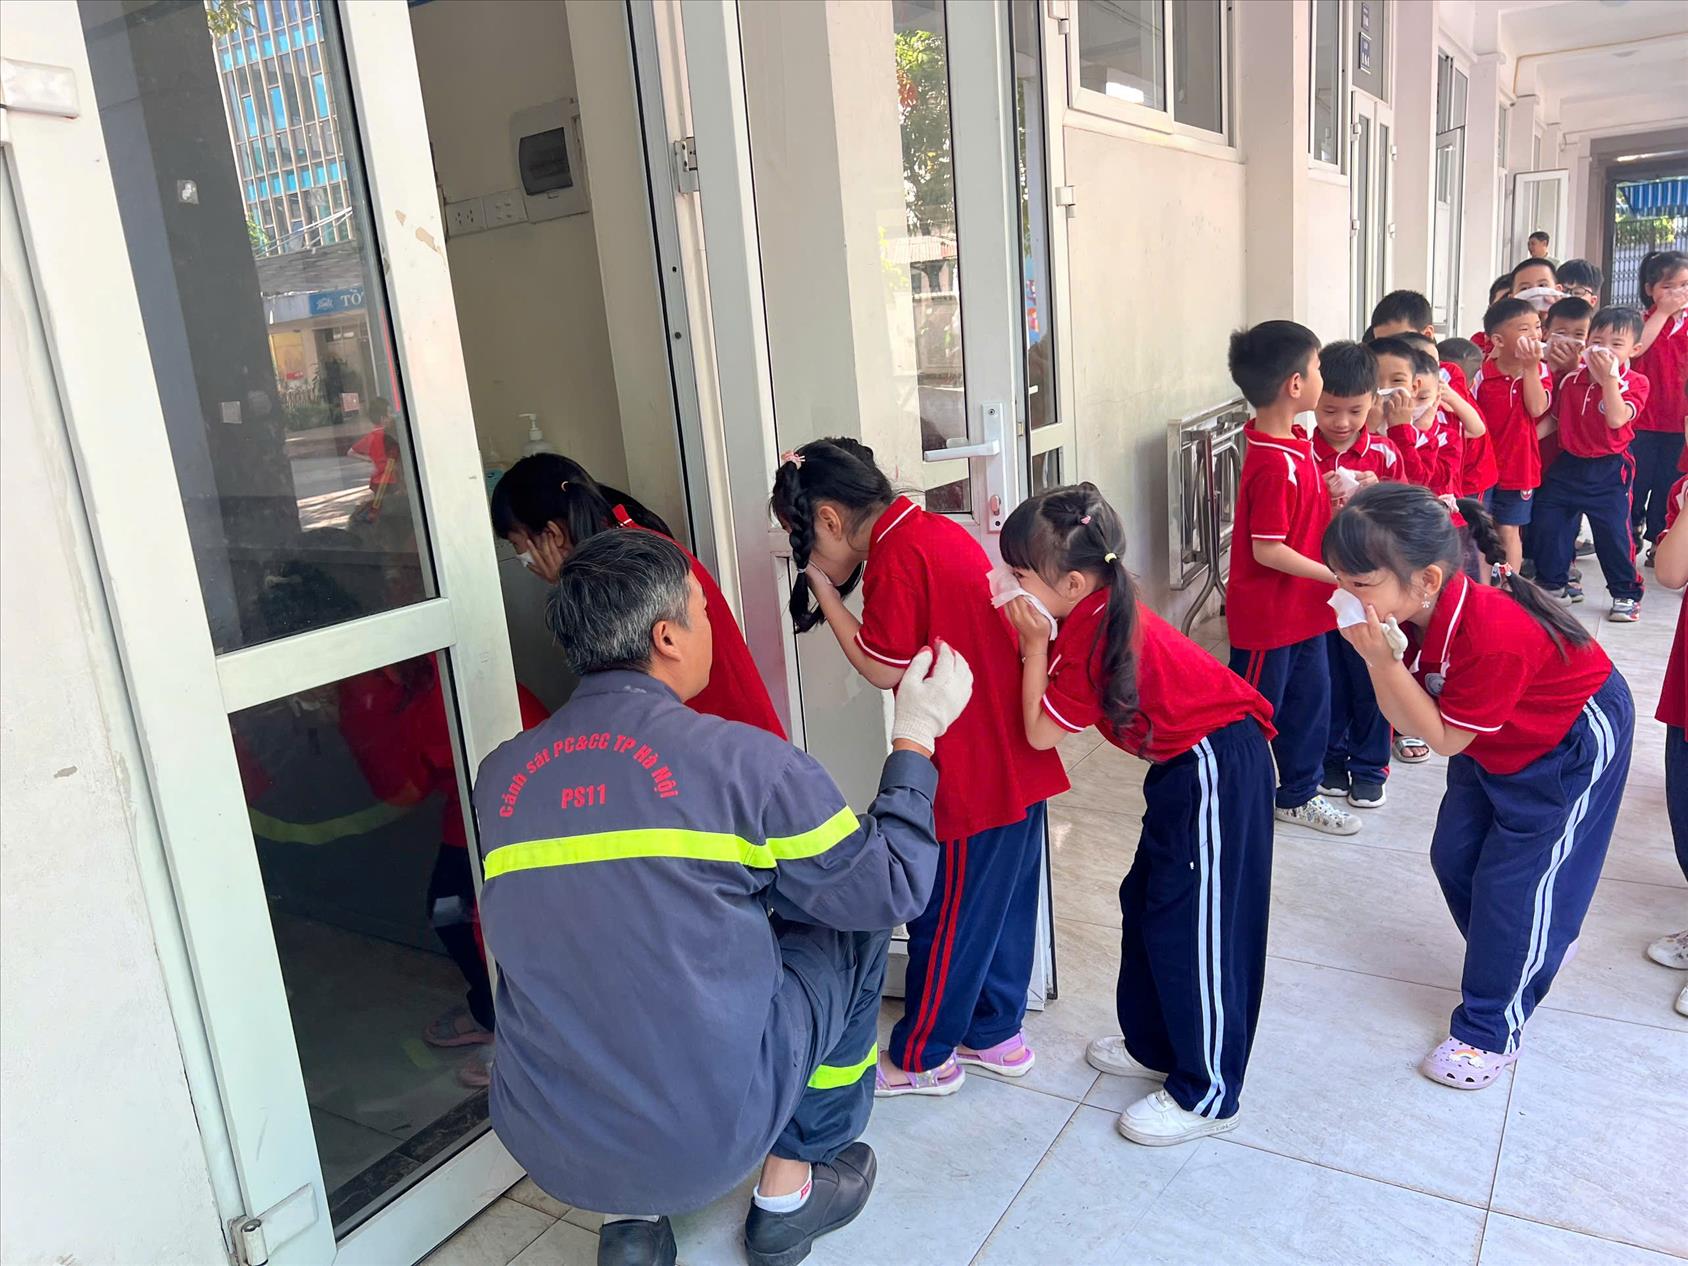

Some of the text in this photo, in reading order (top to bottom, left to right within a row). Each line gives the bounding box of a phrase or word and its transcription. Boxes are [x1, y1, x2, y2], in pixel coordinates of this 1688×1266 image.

[553, 733, 611, 757] PC&CC
[614, 735, 636, 752] TP
[633, 744, 659, 768] Hà
[652, 766, 679, 798] Nội
[561, 784, 607, 808] PS11
